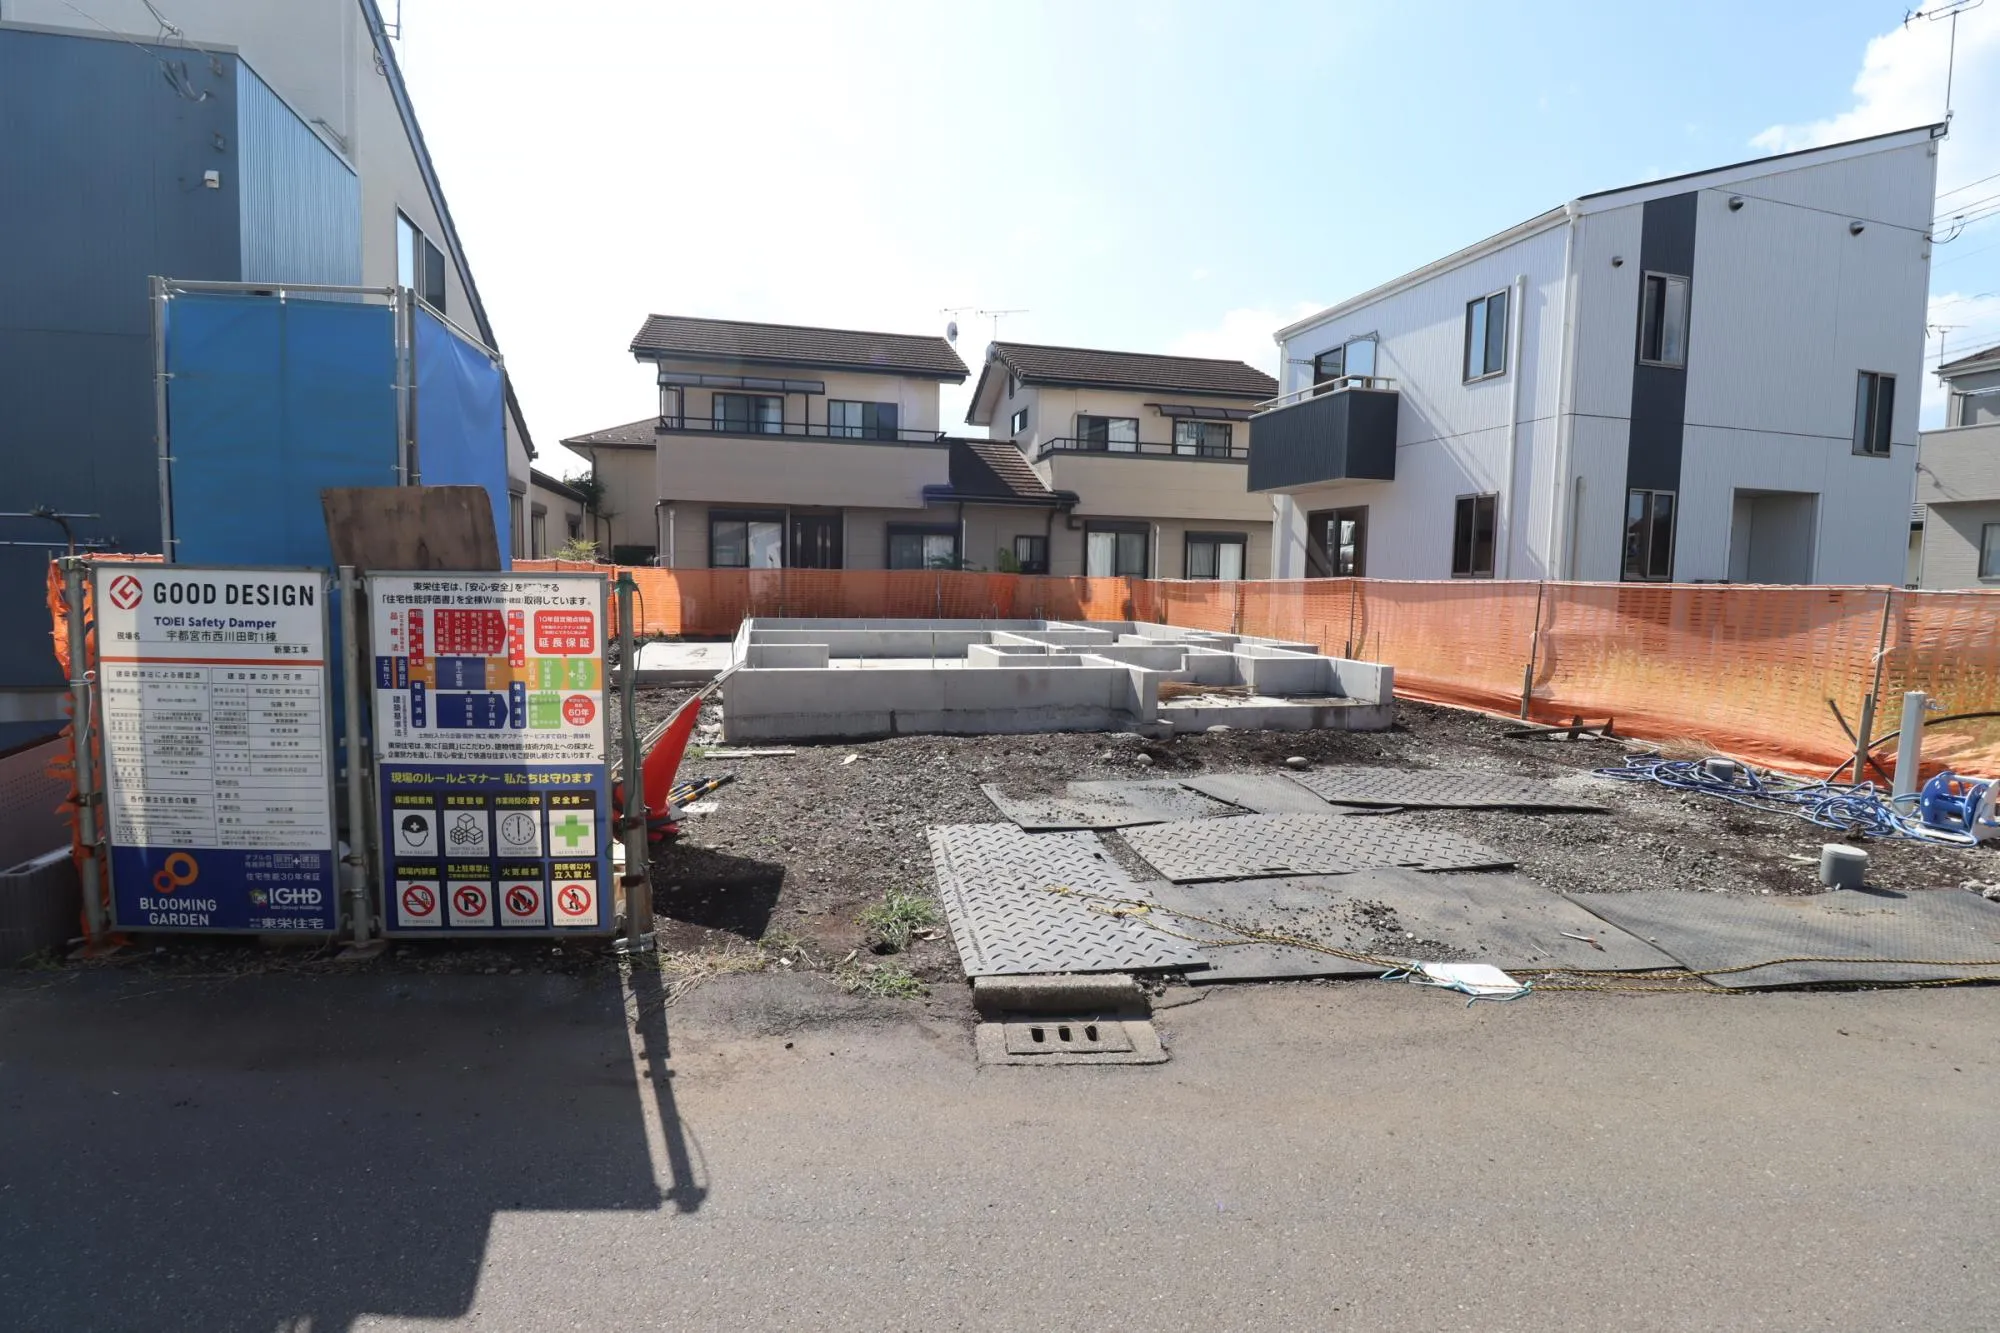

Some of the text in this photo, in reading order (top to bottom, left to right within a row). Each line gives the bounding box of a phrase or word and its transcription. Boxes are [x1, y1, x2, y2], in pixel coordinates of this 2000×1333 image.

[153, 582, 314, 606] GOOD DESIGN
[188, 617, 225, 630] Safety
[229, 618, 277, 631] Damper
[117, 631, 141, 641] 現場名
[538, 637, 590, 648] 延長保証
[274, 645, 309, 654] 新築工事
[568, 709, 590, 717] 60年
[391, 772, 594, 784] 現場のルールとマナー 私たちは守ります
[552, 796, 590, 805] 安全第一
[502, 867, 539, 876] 火気厳禁
[554, 863, 591, 871] 関係者以外
[554, 871, 592, 879] 立入禁止
[140, 898, 217, 911] BLOOMING
[149, 913, 209, 926] GARDEN
[262, 917, 324, 929] 東栄住宅
